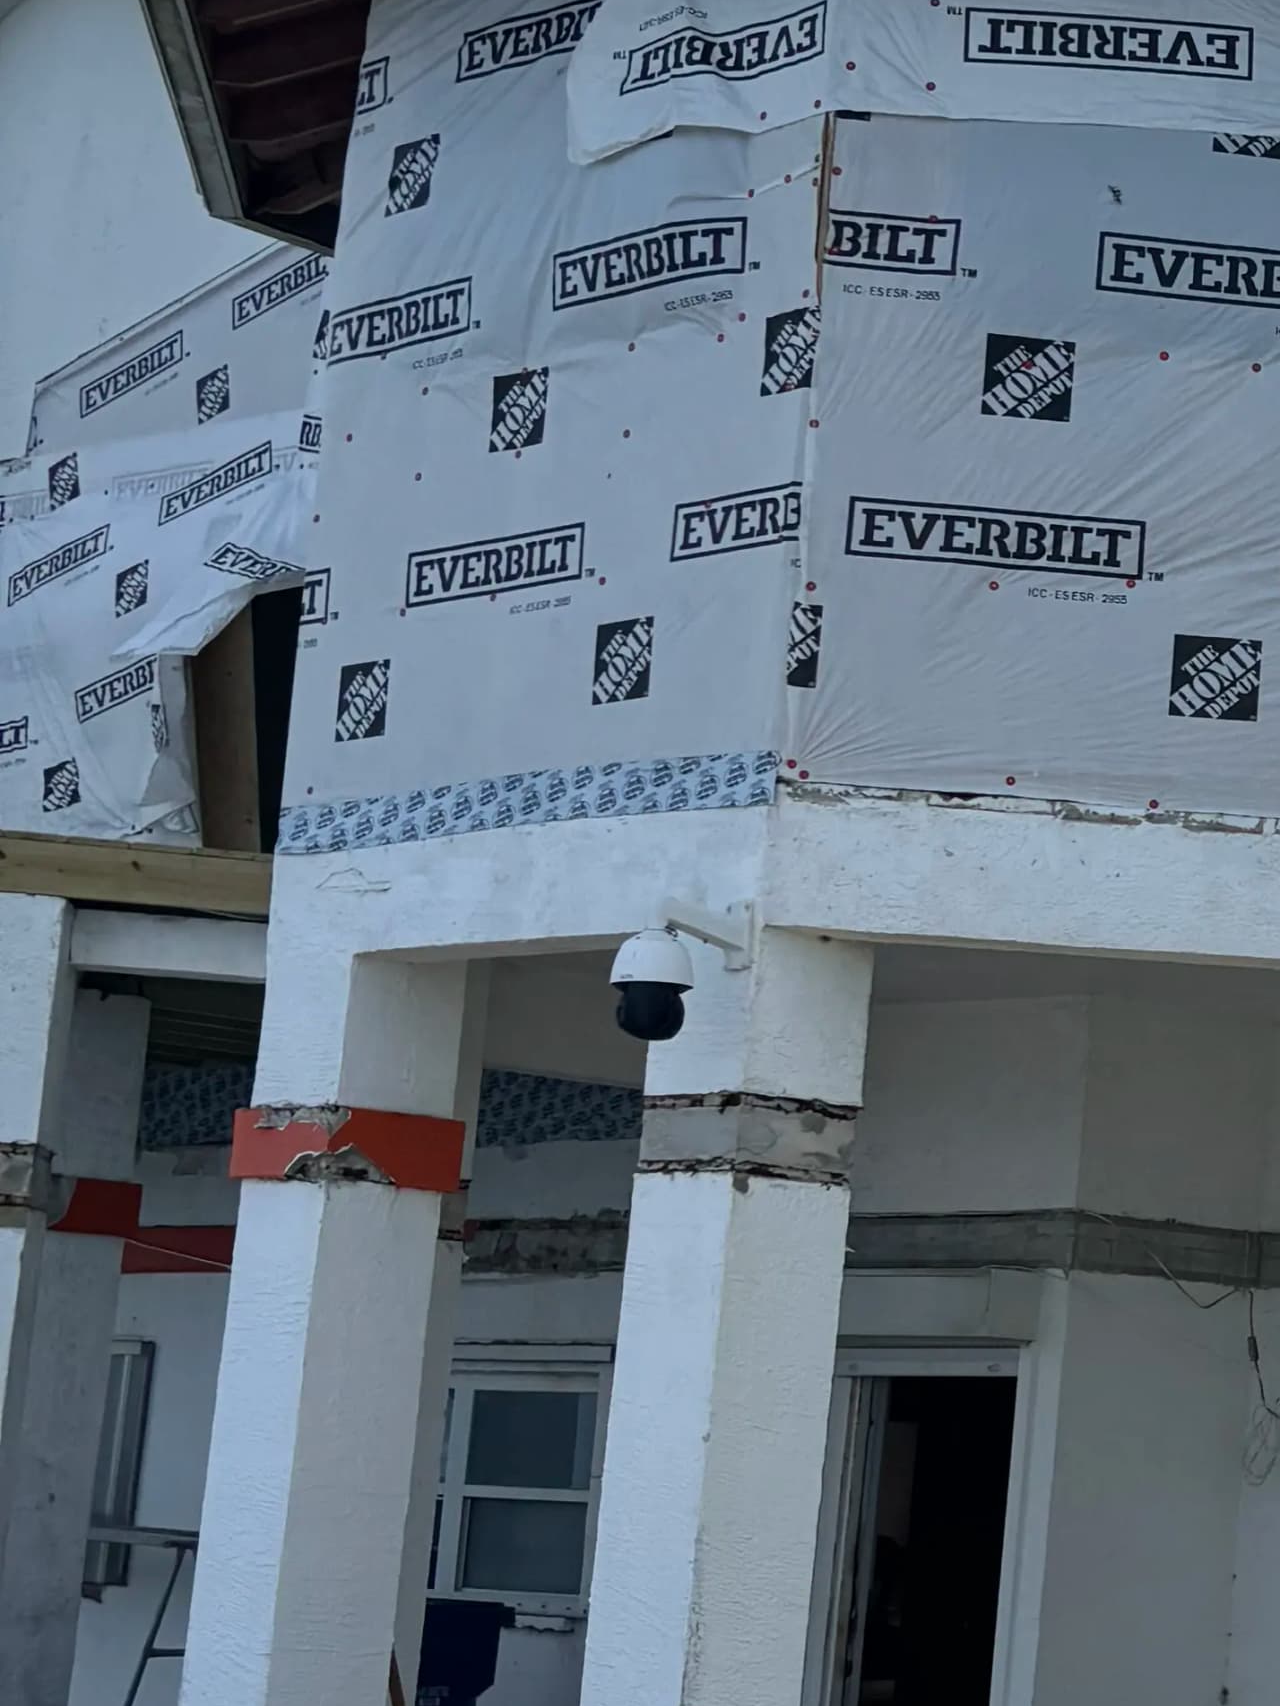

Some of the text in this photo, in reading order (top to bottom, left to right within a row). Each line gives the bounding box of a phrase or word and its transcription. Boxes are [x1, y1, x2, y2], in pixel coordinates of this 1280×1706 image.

[464, 1, 603, 73] EVERBI
[631, 13, 819, 84] EVERBILT
[977, 18, 1240, 70] EVERBILT
[558, 227, 735, 300] EVERBILT
[828, 219, 947, 265] BILT
[236, 253, 329, 324] EVERBIL
[329, 287, 465, 360] EVERBILT
[84, 338, 179, 411] EVERBILT
[982, 340, 1075, 416] HOME
[993, 345, 1033, 377] THE
[1016, 371, 1073, 418] DEPOT
[490, 369, 548, 451] HOME
[162, 449, 270, 519] EVERBILT
[679, 492, 801, 551] EVERB
[859, 507, 1164, 581] EVERBILT TM
[12, 530, 105, 598] EVERBILT
[413, 534, 576, 597] EVERBILT
[593, 618, 654, 704] HOME
[600, 629, 627, 663] THE
[614, 646, 652, 701] DEPOT
[1170, 640, 1262, 717] HOME
[1181, 645, 1220, 677] THE
[79, 658, 157, 716] EVERBI
[336, 660, 390, 741] HOME
[1203, 670, 1260, 719] DEPOT
